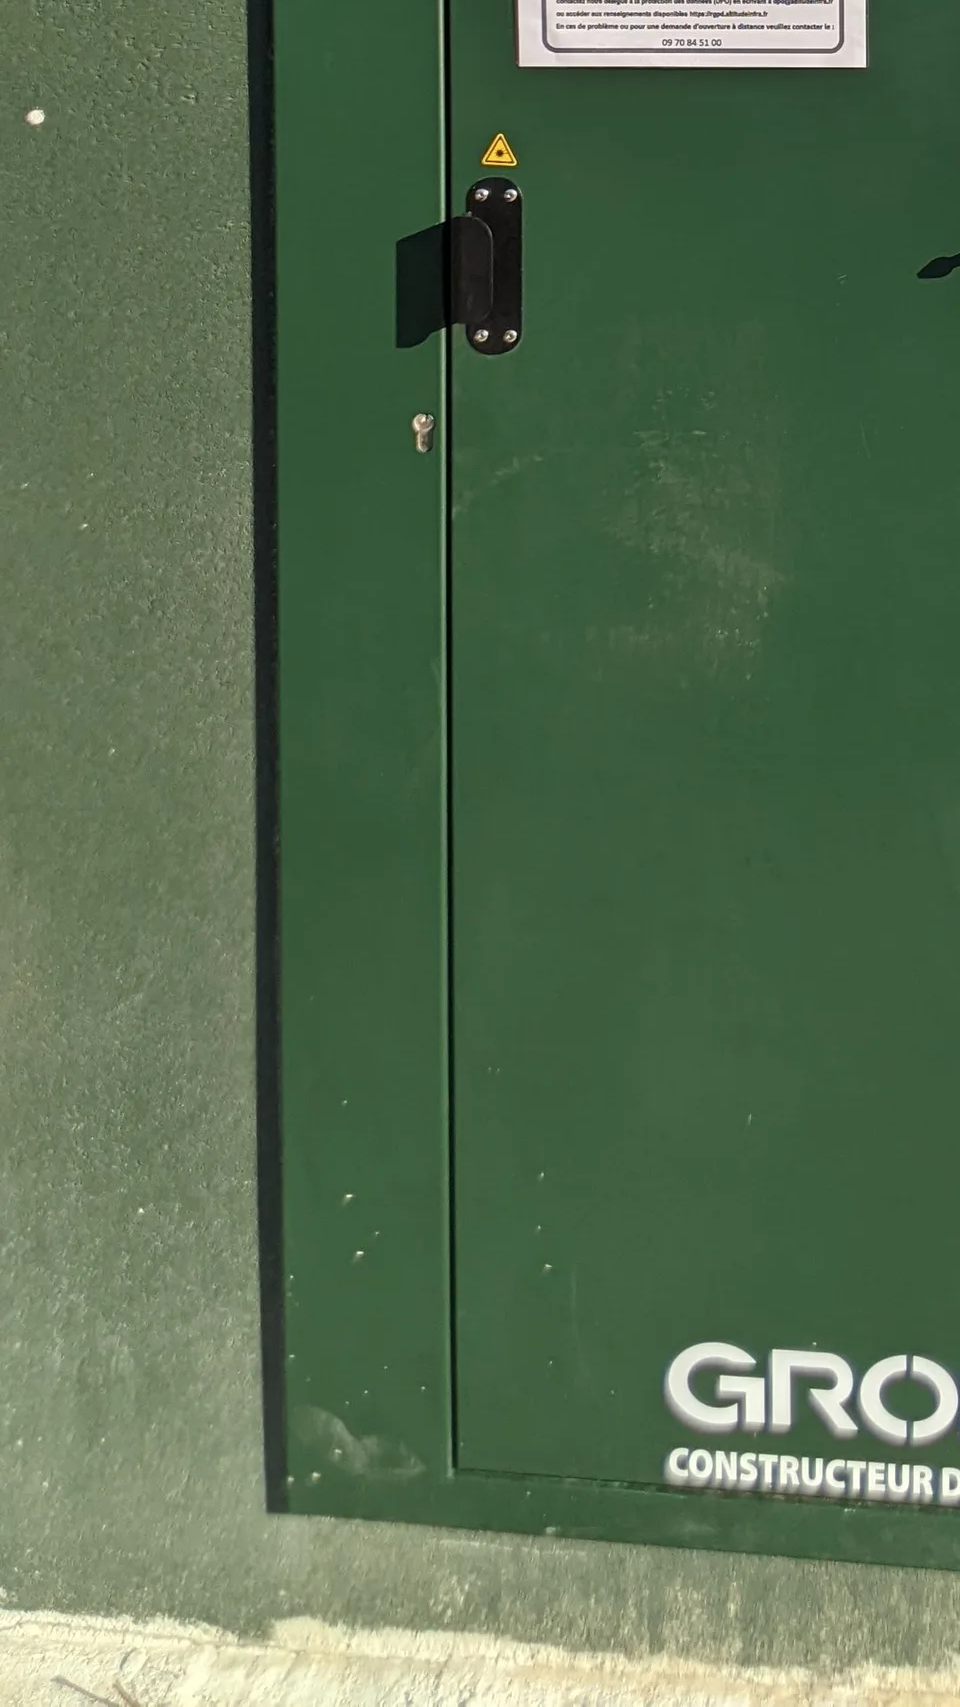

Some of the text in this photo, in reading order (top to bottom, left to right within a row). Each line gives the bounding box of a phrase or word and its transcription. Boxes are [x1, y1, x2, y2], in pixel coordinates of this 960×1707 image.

[662, 38, 722, 48] 09 70 84 51 00
[668, 1447, 933, 1498] CONSTRUCTEUR
